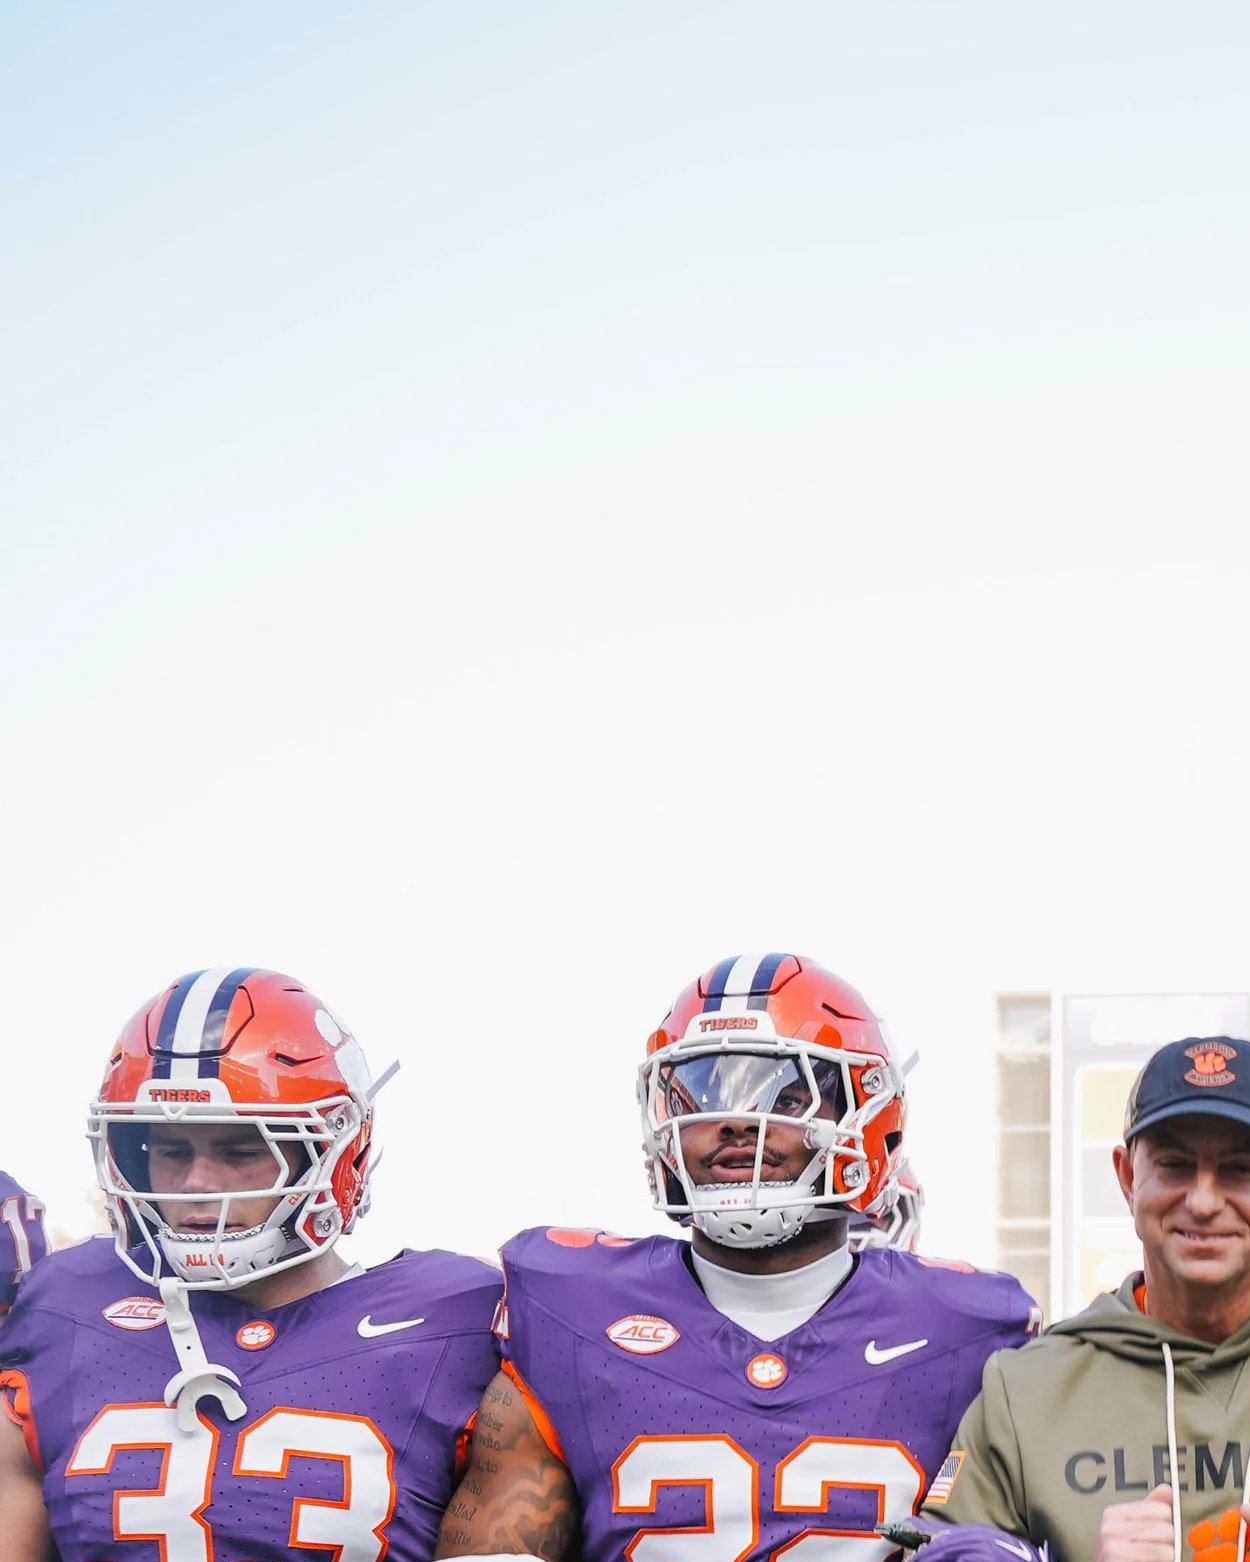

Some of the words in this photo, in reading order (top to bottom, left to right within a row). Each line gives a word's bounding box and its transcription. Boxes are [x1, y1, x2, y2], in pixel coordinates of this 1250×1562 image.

[699, 1016, 758, 1032] TIGERS
[148, 1089, 211, 1102] TIGERS
[186, 1254, 208, 1266] ALL
[112, 1304, 165, 1317] ACC
[619, 1325, 669, 1339] ACC
